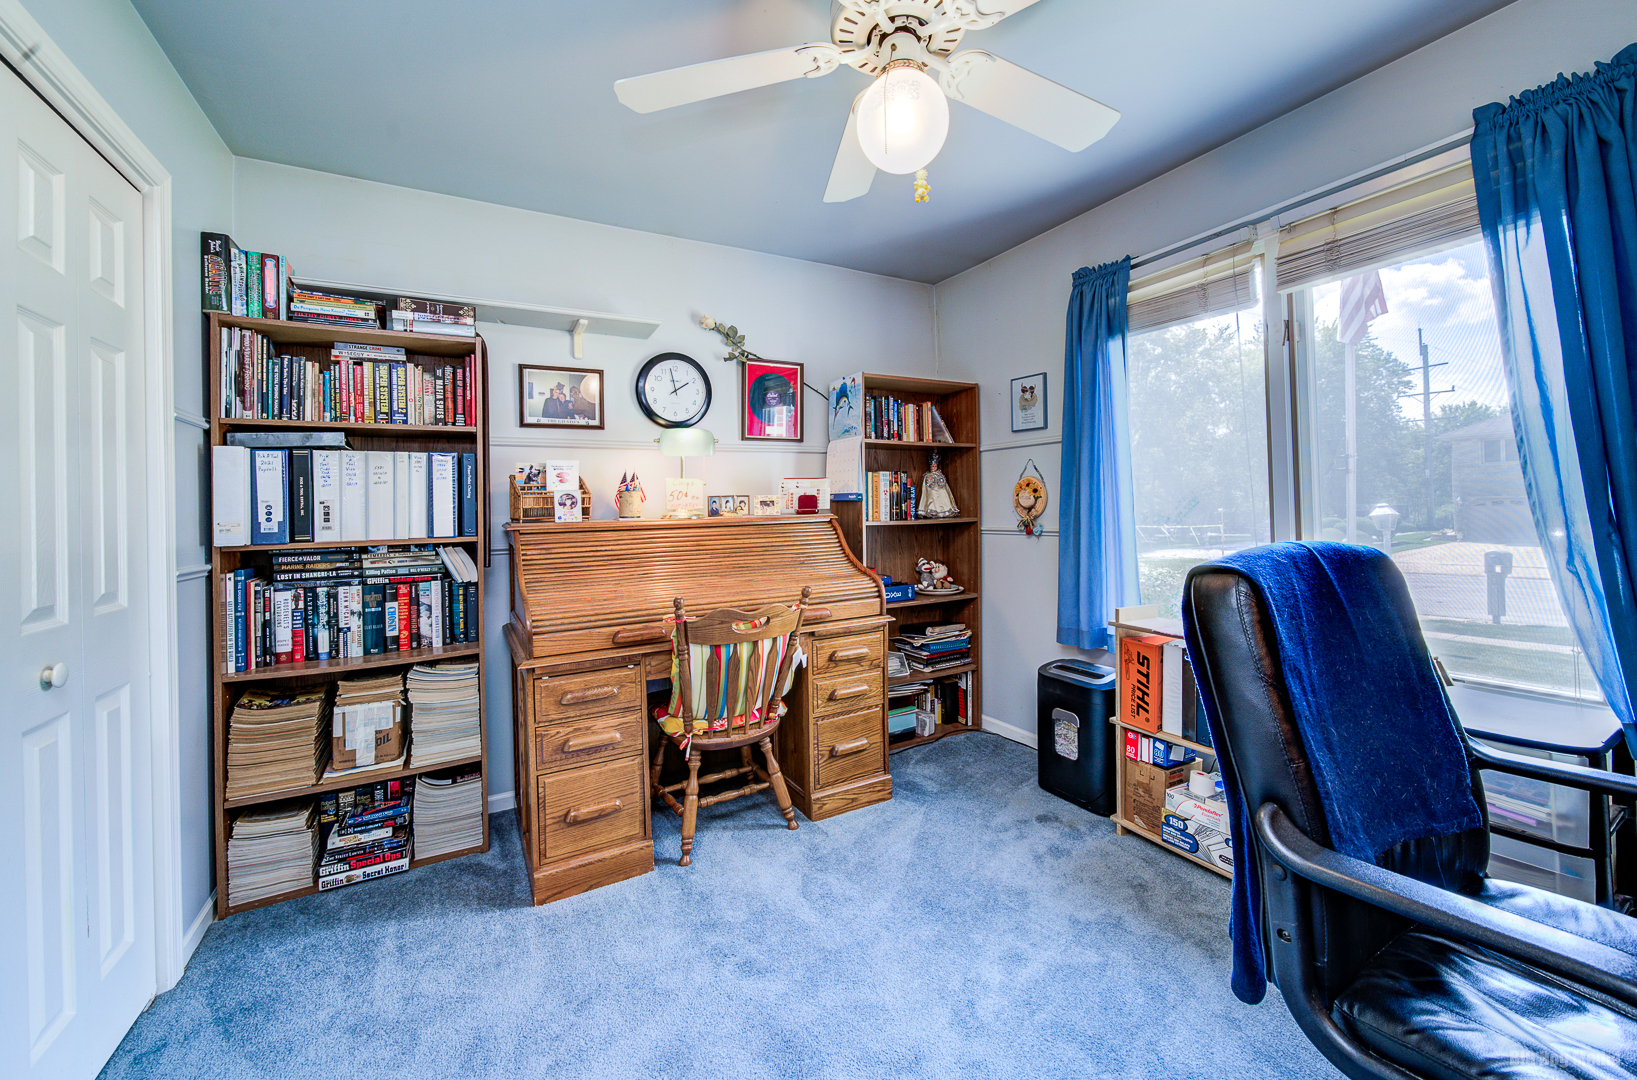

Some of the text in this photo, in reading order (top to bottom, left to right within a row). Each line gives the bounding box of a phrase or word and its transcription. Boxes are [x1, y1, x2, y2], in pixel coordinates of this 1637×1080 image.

[208, 254, 228, 295] GIGANTIC
[397, 367, 405, 385] SUPER
[379, 365, 389, 413] SUPER SYSTEM
[398, 385, 406, 407] SYSTEM
[435, 379, 444, 419] MAFIA SPIES
[672, 479, 695, 491] Chips
[301, 570, 337, 579] SHANGRI-LA
[367, 577, 389, 585] Griffin
[387, 606, 397, 632] CHOSIN
[1136, 650, 1151, 717] STIHL
[375, 732, 392, 747] OIL
[1126, 745, 1136, 754] 80
[1154, 748, 1164, 757] 80
[1168, 816, 1184, 829] 150
[349, 849, 364, 857] LAWYER
[319, 852, 401, 876] Griffin Special Ops
[321, 864, 405, 889] Griffin Secret Honor
